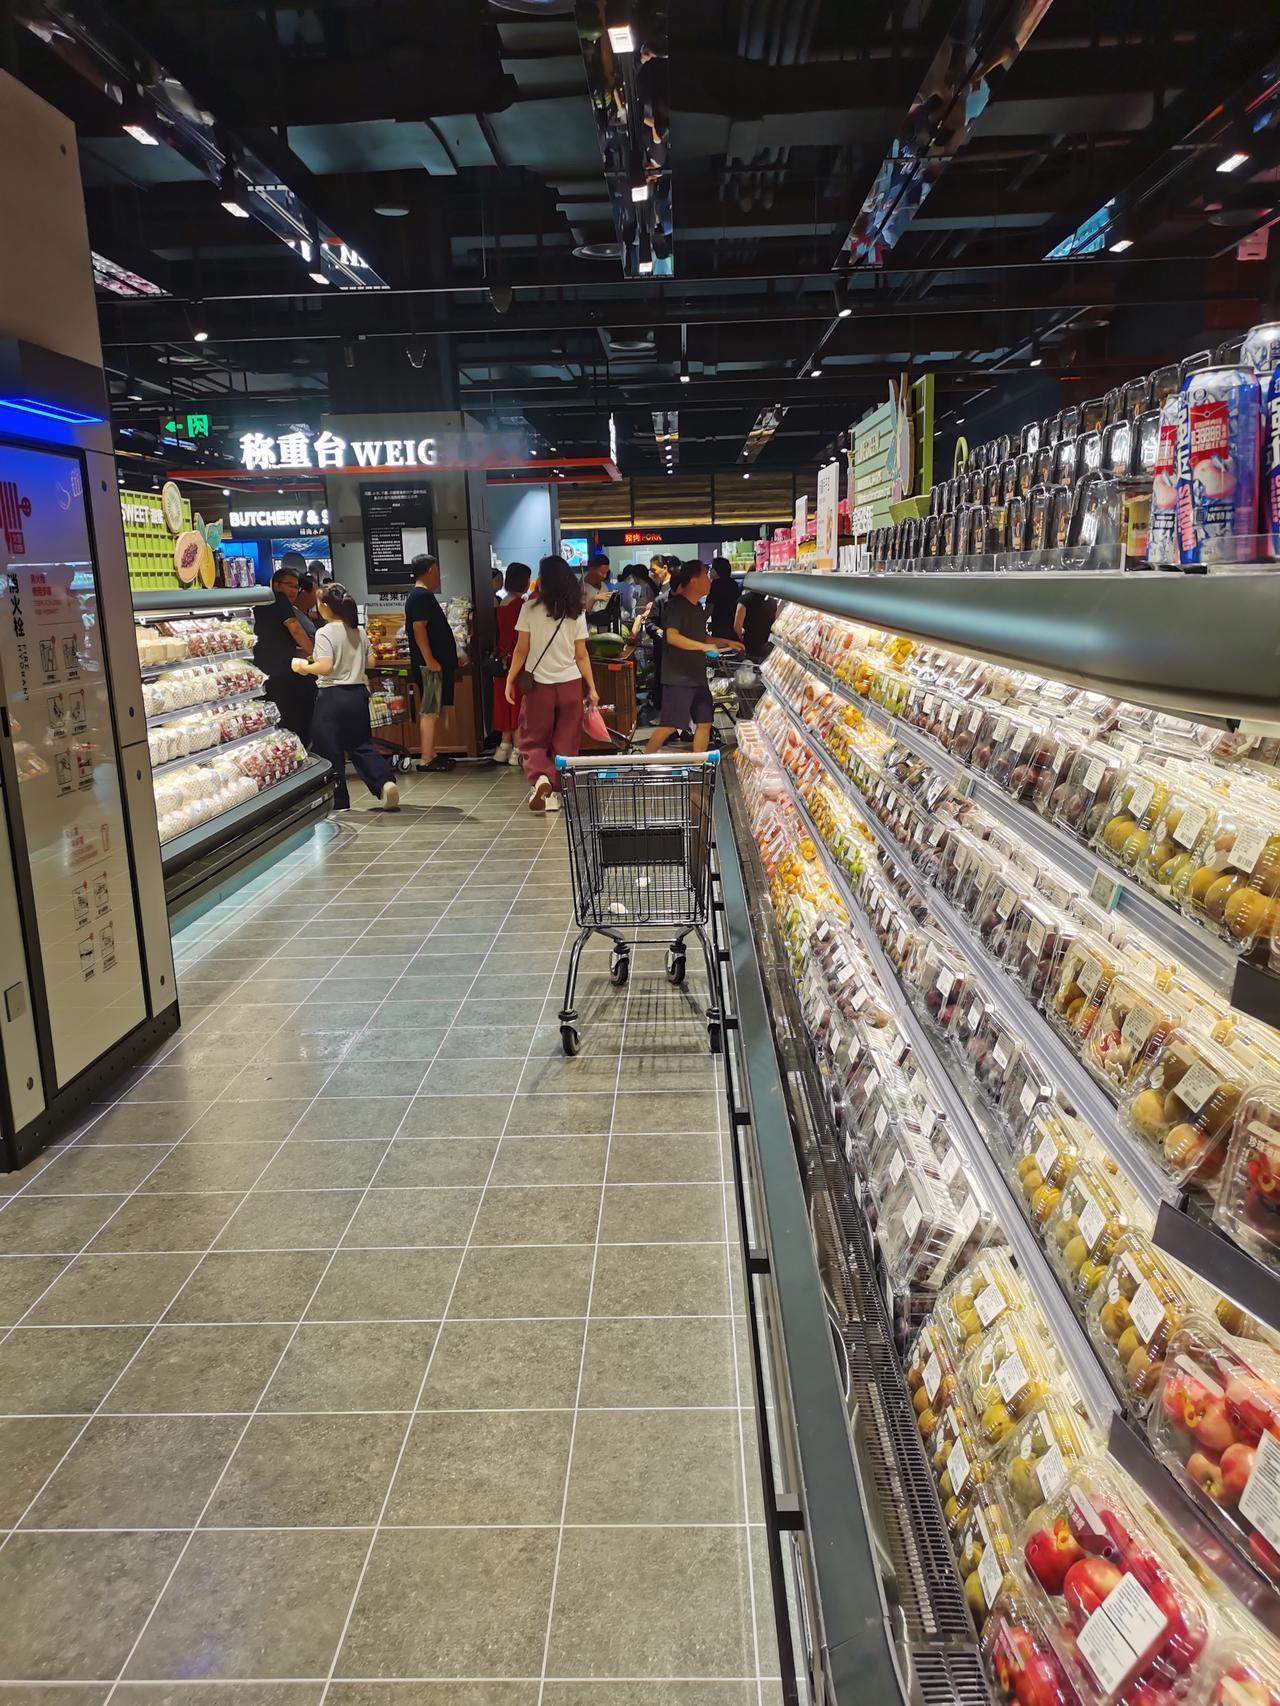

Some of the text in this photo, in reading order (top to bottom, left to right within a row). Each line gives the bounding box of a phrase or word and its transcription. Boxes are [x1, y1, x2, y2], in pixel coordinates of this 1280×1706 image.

[239, 431, 346, 470] 称重台
[229, 510, 304, 528] BUTCHERY
[306, 509, 320, 526] &
